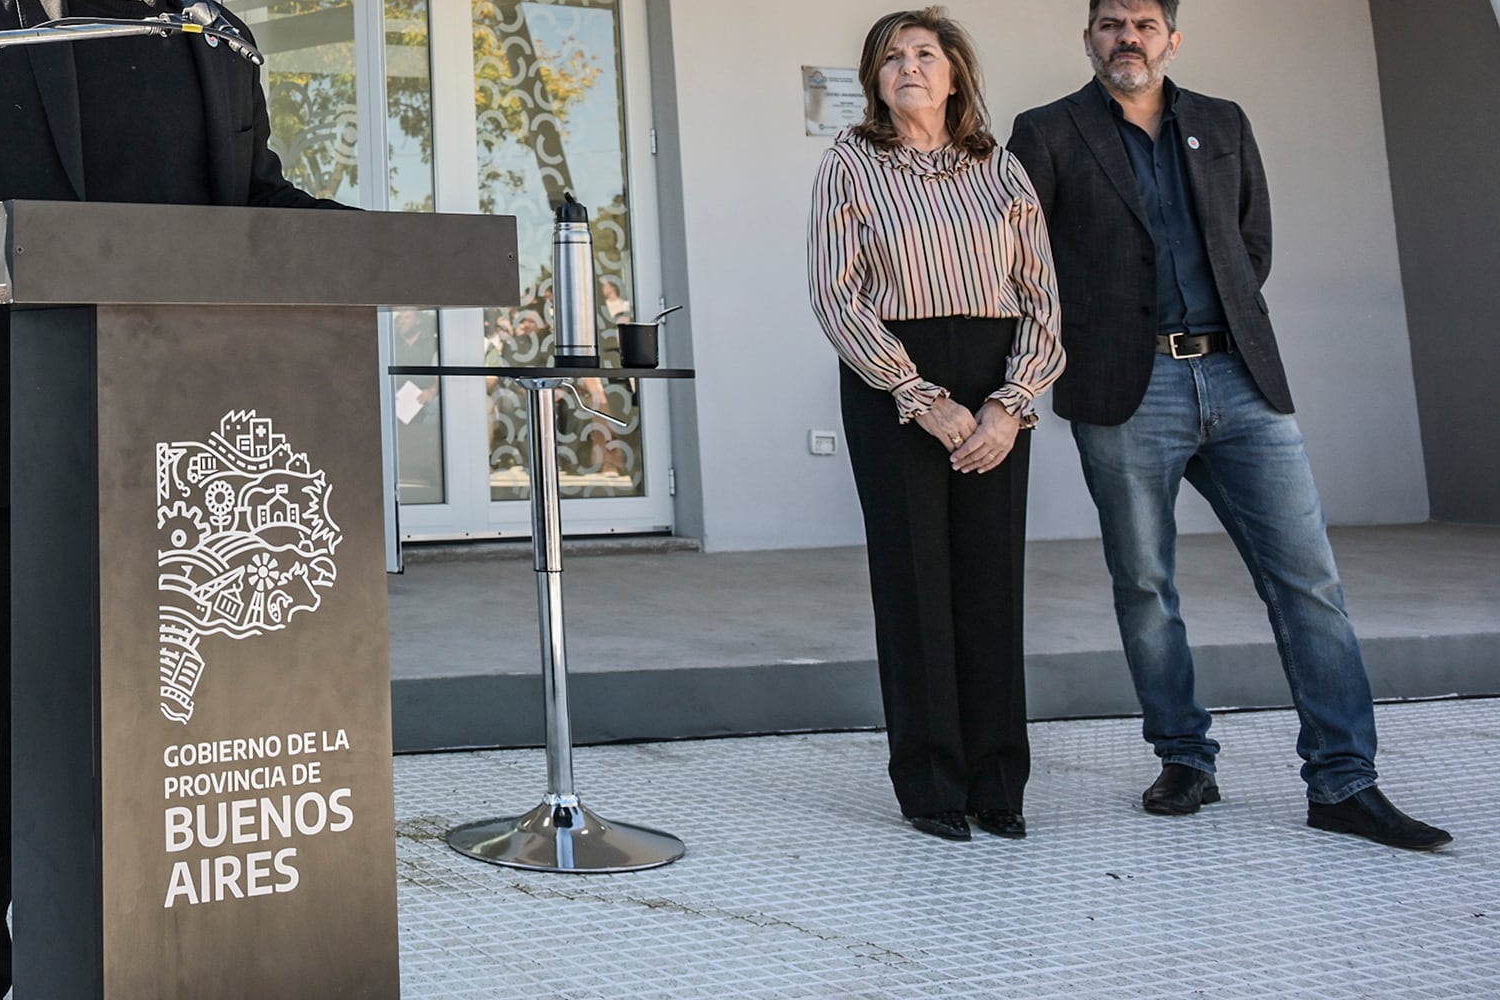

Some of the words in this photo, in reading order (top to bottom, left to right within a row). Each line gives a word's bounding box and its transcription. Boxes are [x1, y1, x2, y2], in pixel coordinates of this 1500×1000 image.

[164, 736, 281, 767] GOBIERNO
[288, 732, 317, 755] DE
[322, 729, 350, 752] LA
[164, 766, 286, 799] PROVINCIA
[292, 761, 321, 785] DE
[165, 788, 354, 852] BUENOS
[163, 848, 300, 908] AIRES
